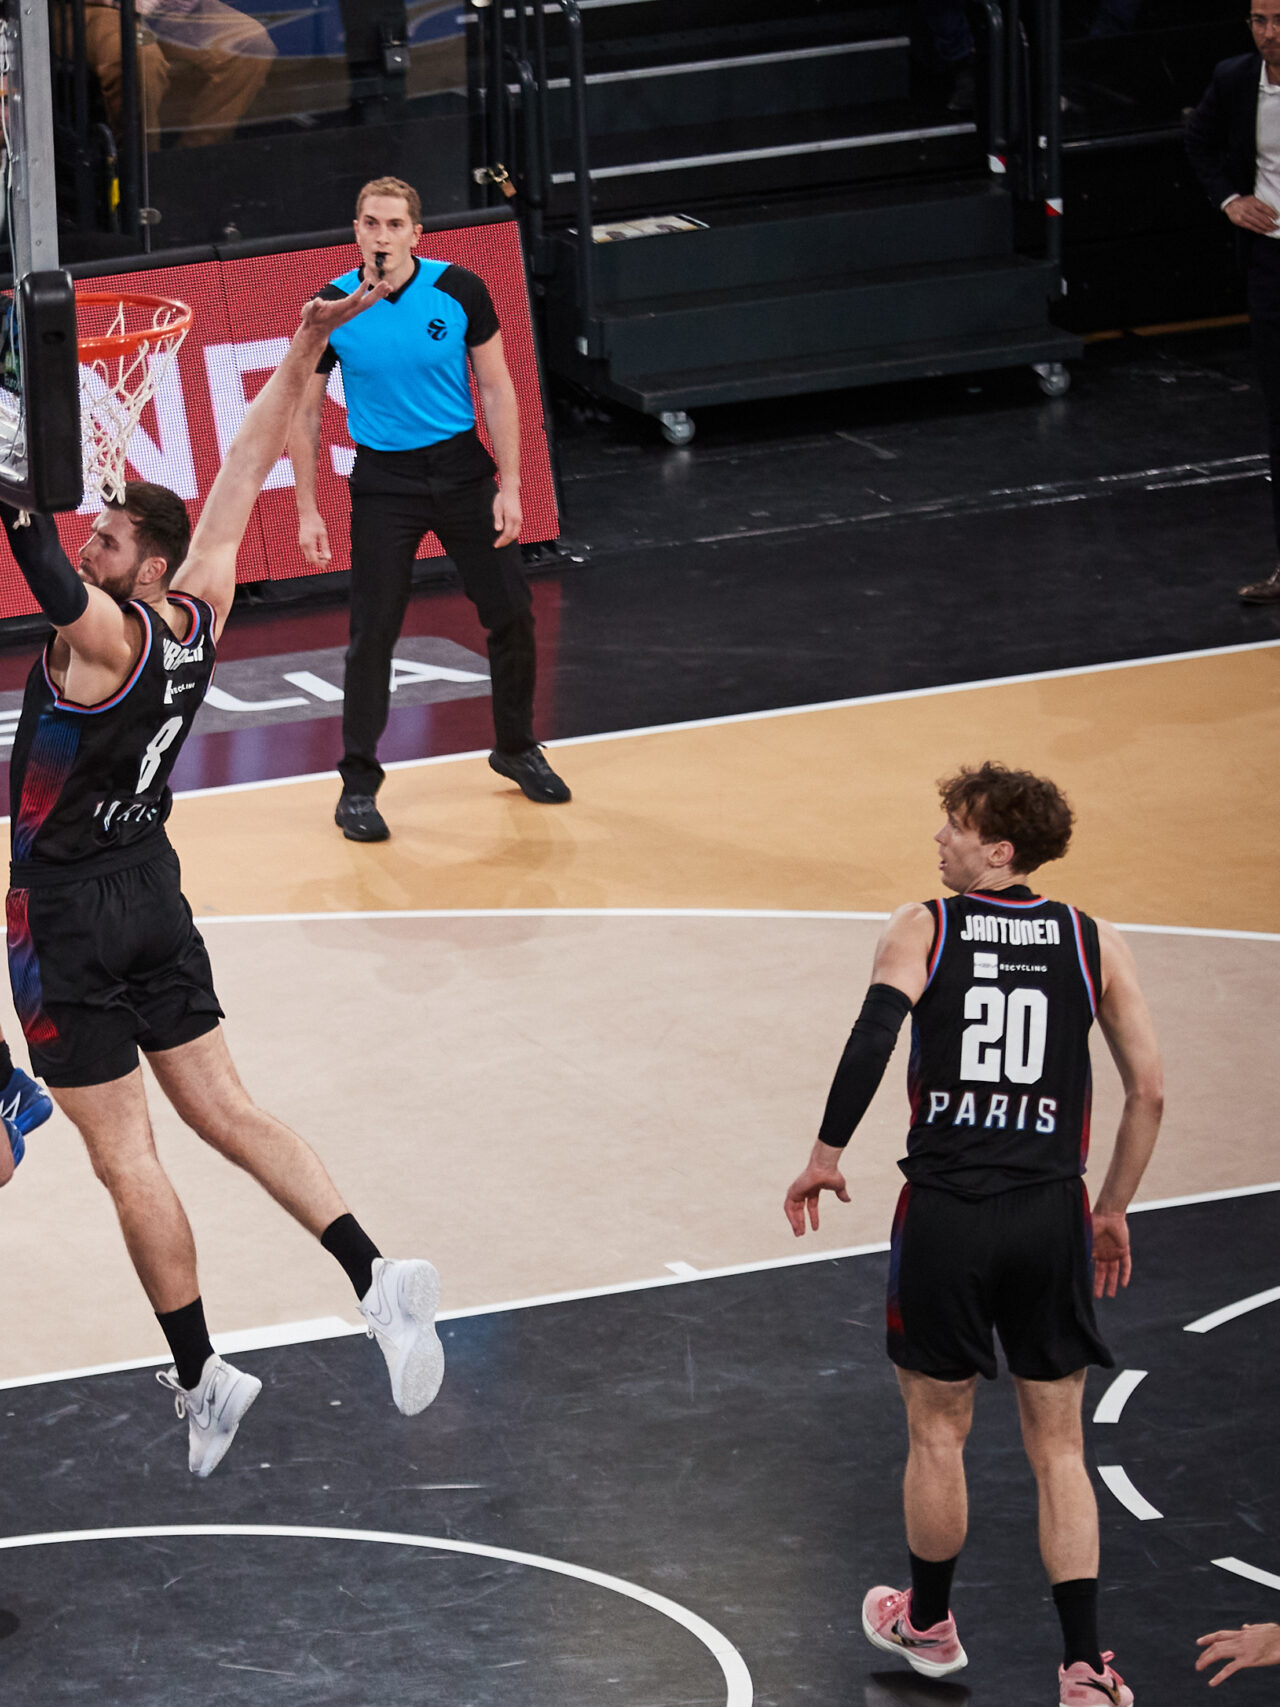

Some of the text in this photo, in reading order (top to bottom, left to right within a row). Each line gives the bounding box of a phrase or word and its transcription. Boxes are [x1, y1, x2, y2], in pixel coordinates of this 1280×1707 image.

[135, 716, 183, 794] 8
[960, 914, 1061, 946] JANTUNEN
[999, 963, 1048, 973] RECYCLING
[959, 986, 1049, 1085] 20
[926, 1091, 1058, 1135] PARIS
